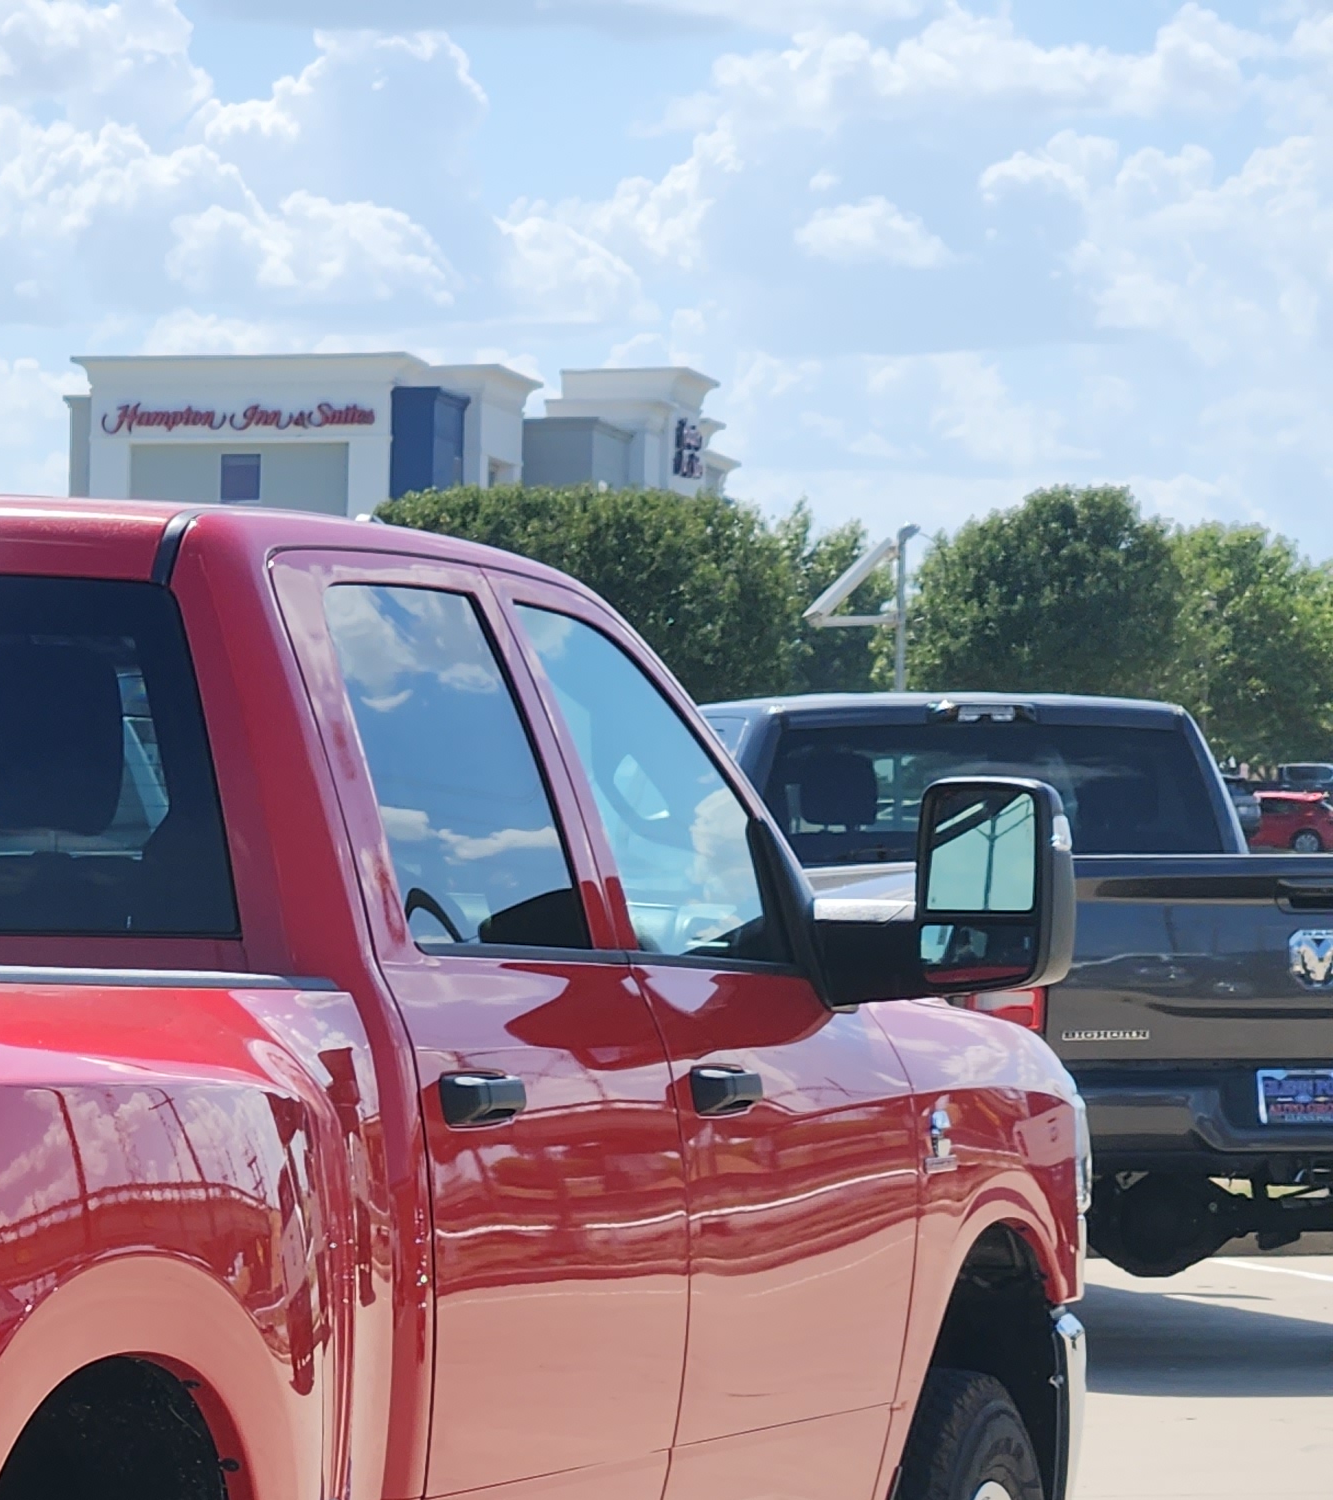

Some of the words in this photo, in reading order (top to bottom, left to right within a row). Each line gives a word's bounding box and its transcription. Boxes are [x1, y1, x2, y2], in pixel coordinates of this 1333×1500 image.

[101, 402, 226, 434] Hampton
[229, 403, 293, 430] Inn
[308, 402, 375, 427] Suites
